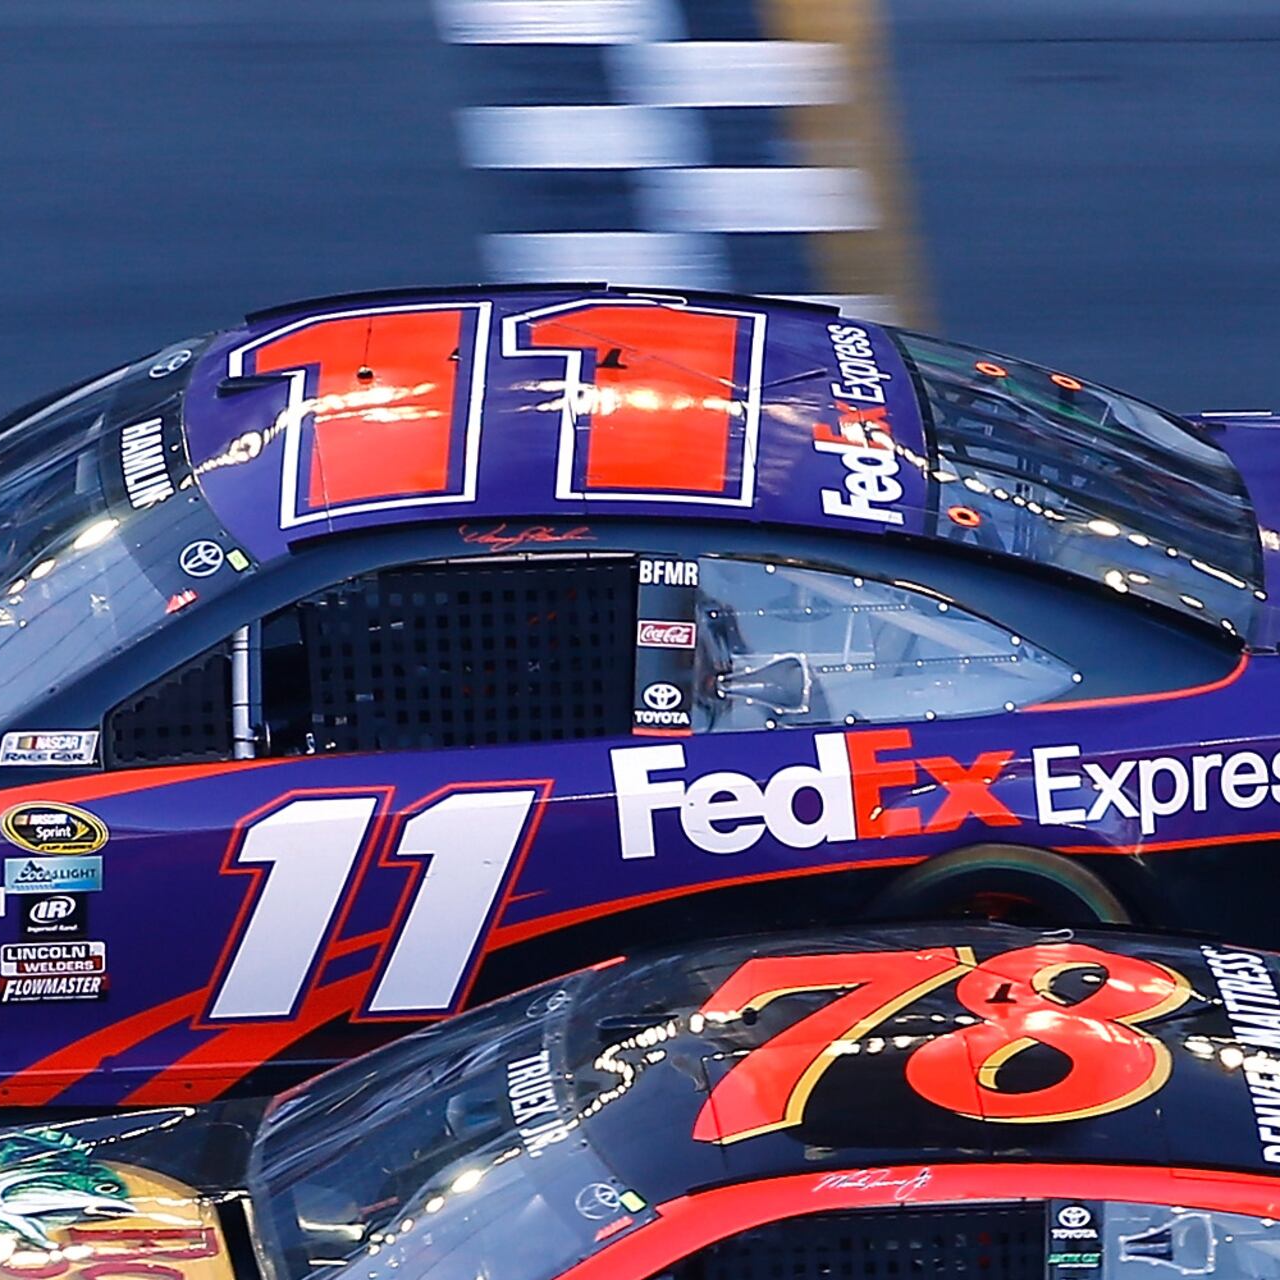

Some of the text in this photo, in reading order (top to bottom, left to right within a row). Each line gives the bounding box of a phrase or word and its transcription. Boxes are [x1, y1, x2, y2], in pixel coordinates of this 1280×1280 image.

[827, 323, 892, 404] Express
[228, 298, 767, 530] 11
[121, 417, 175, 508] HAMLIN
[639, 560, 699, 586] BFMR
[634, 710, 691, 725] TOYOTA
[34, 734, 80, 751] NASCAR
[4, 752, 85, 761] RACE CAR
[609, 728, 1023, 860] FedEx
[35, 825, 72, 841] Sprint
[59, 868, 97, 880] LIGHT
[207, 788, 539, 1021] 11
[7, 945, 87, 961] LINCOLN
[23, 960, 95, 972] WELDERS
[2, 976, 102, 1002] FLOWMASTER
[691, 944, 1192, 1145] 78
[507, 1050, 560, 1125] TRUEX
[1051, 1229, 1098, 1239] TOYOTA
